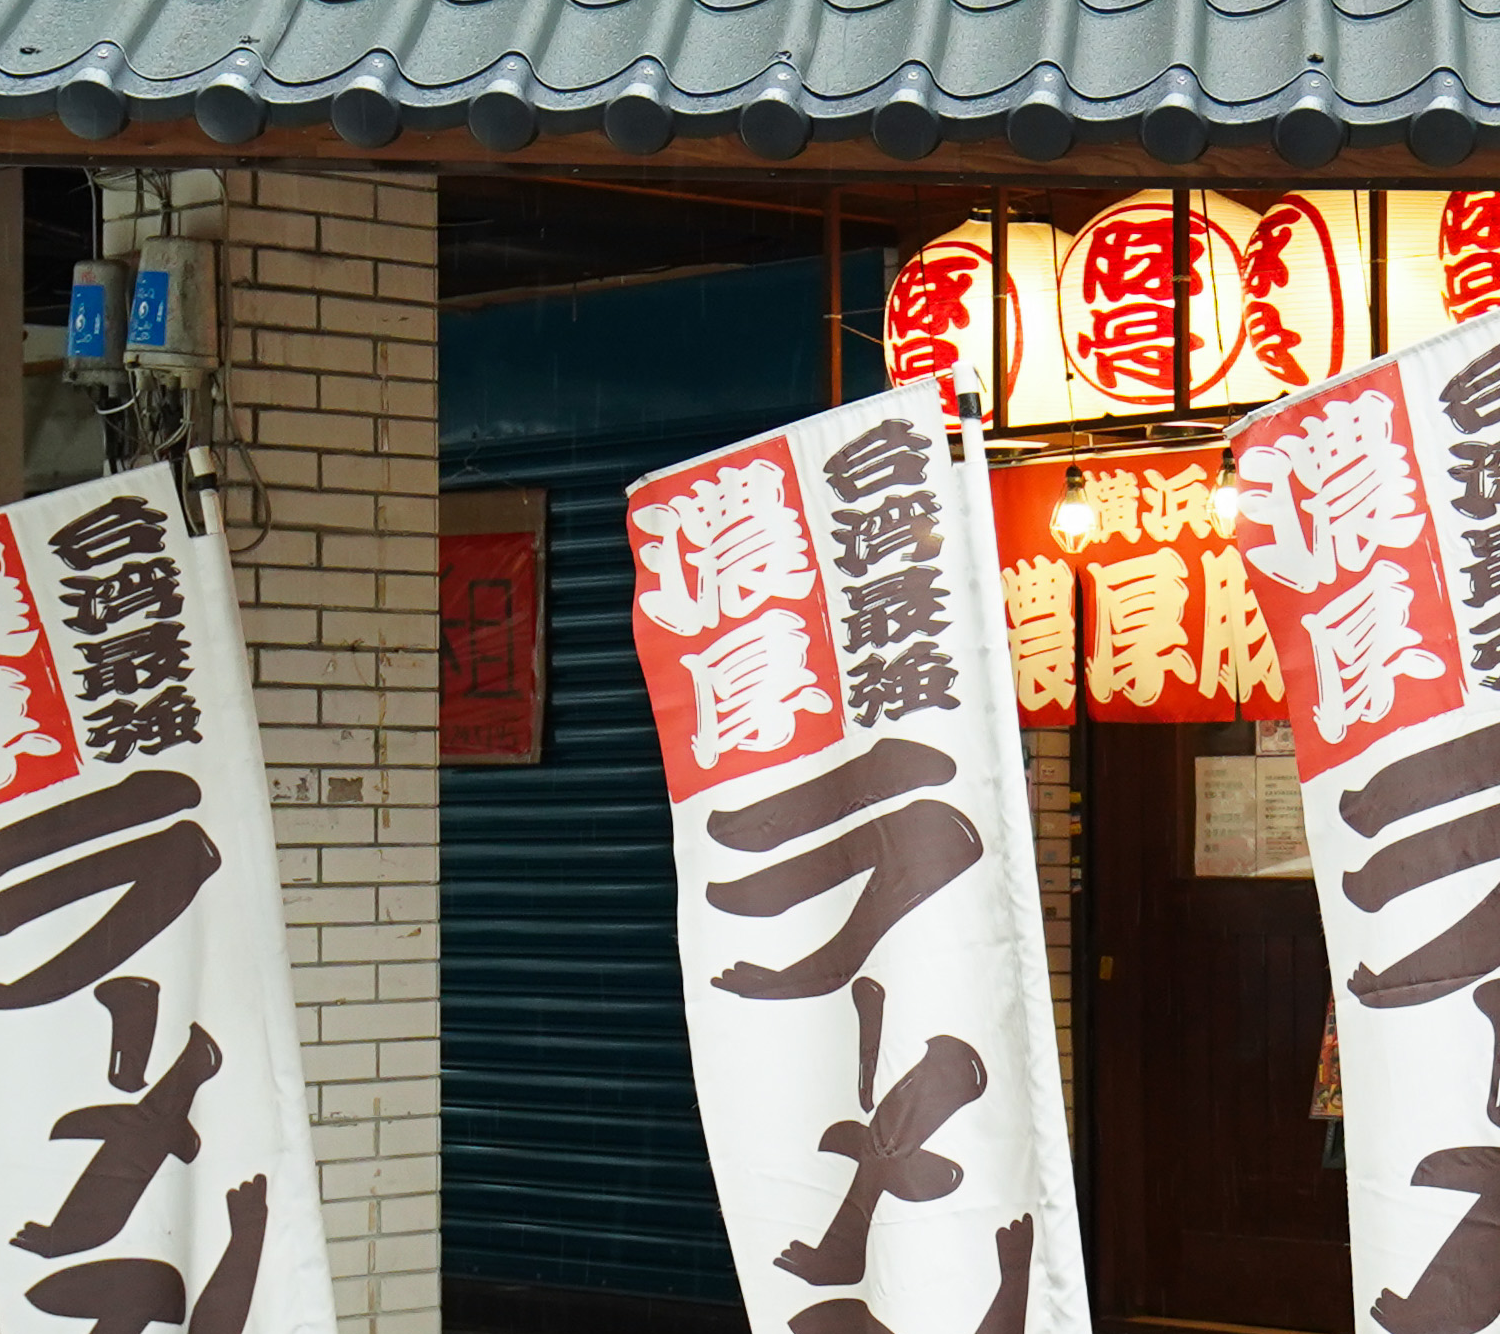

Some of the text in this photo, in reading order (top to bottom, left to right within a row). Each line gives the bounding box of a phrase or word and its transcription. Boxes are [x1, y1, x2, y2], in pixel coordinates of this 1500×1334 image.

[48, 496, 203, 766] 台湾最強
[636, 457, 833, 770] 濃厚
[824, 417, 961, 729] 台湾最強
[1236, 388, 1446, 744] 濃厚
